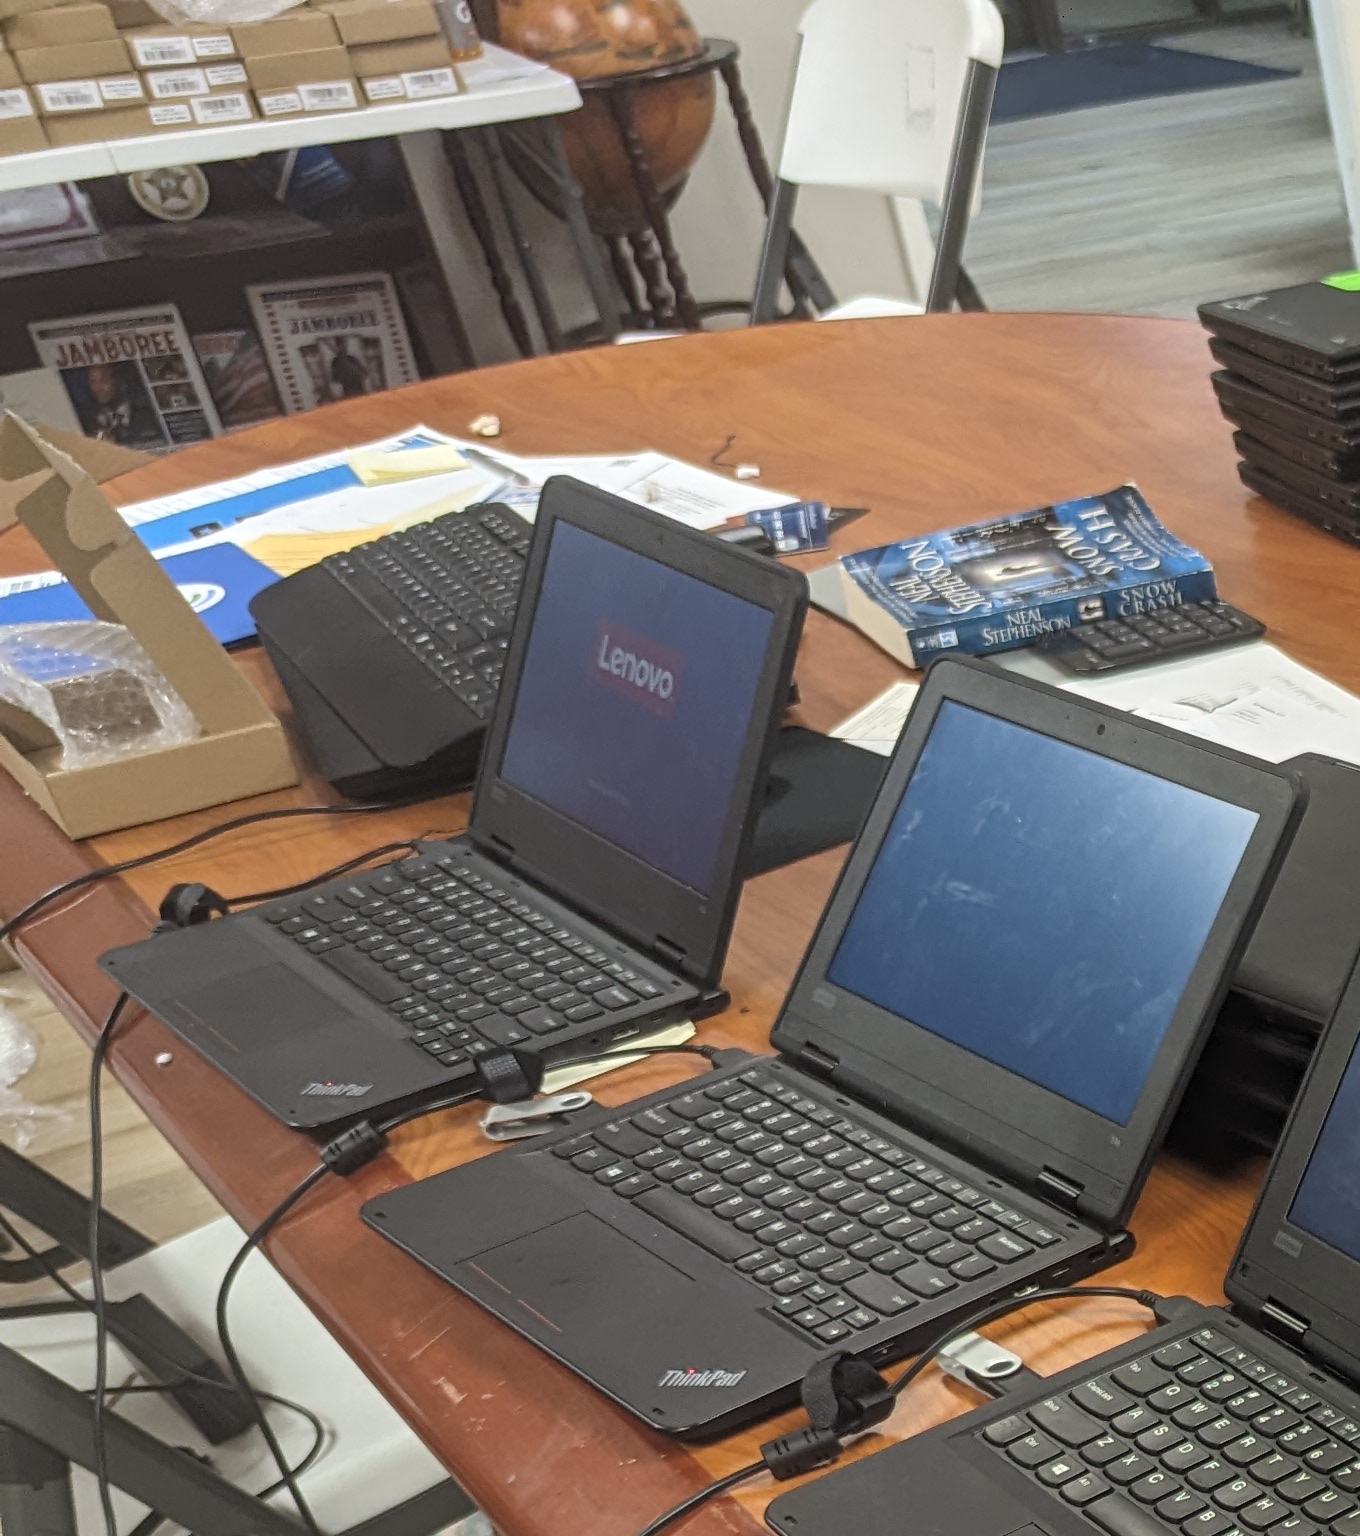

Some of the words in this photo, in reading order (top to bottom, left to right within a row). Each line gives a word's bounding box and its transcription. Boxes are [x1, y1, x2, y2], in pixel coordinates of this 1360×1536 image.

[55, 330, 180, 368] JAMBOREE
[1047, 525, 1124, 576] SNOW
[1079, 505, 1161, 571] CRASH
[1118, 592, 1183, 617] CRASH
[1119, 579, 1178, 600] SNOW
[982, 615, 1072, 648] STEPHENSON
[1006, 607, 1044, 627] NEAL
[598, 634, 675, 699] Lenovo
[658, 1367, 748, 1387] ThinkPad
